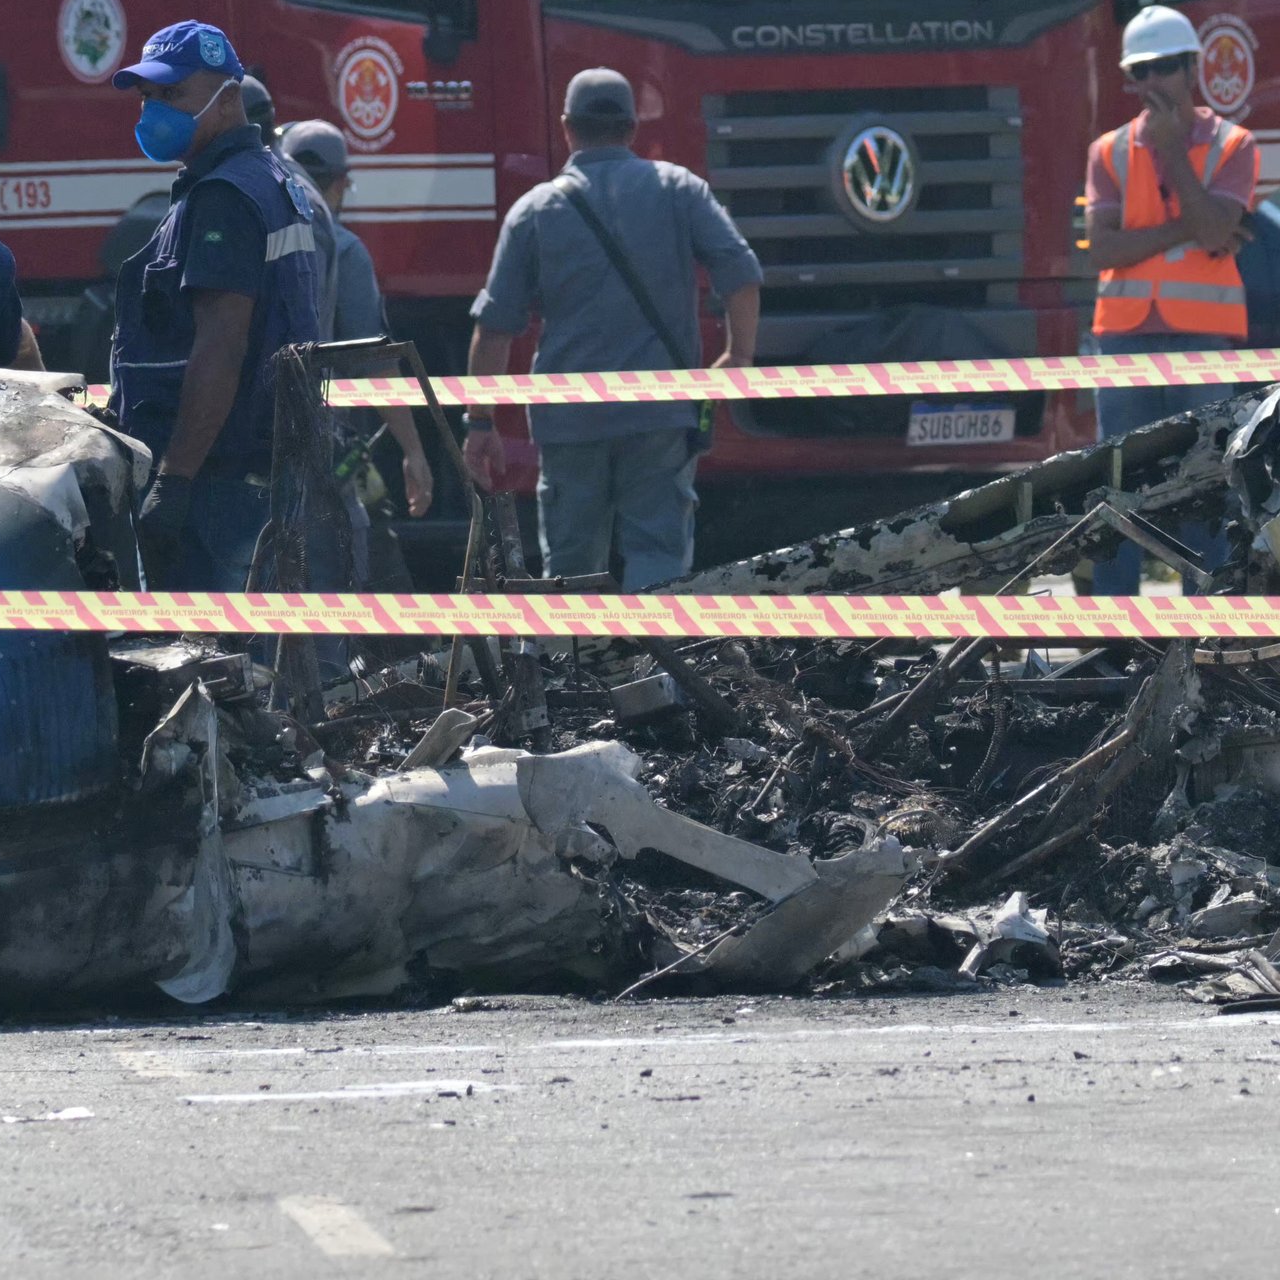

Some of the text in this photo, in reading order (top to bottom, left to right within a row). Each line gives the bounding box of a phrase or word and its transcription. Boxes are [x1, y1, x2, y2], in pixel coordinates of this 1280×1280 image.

[732, 20, 994, 49] CONSTELLATION
[13, 180, 52, 208] 193
[7, 607, 23, 615] NÃO
[24, 607, 74, 616] ULTRAPASSE
[101, 608, 223, 617] BOMBEIROS NÃO ULTRAPASSE
[304, 609, 320, 618] NÃO
[321, 610, 372, 618] ULTRAPASSE
[453, 611, 470, 619] NÃO
[471, 612, 522, 620] ULTRAPASSE
[549, 611, 672, 620] BOMBEIROS NÃO ULTRAPASSE
[699, 612, 823, 620] BOMBEIROS NÃO ULTRAPASSE
[851, 613, 976, 621] BOMBEIROS NÃO ULTRAPASSE
[1003, 613, 1128, 621] BOMBEIROS NÃO ULTRAPASSE
[1154, 613, 1204, 621] BOMBEIROS
[1210, 612, 1227, 620] NÃO
